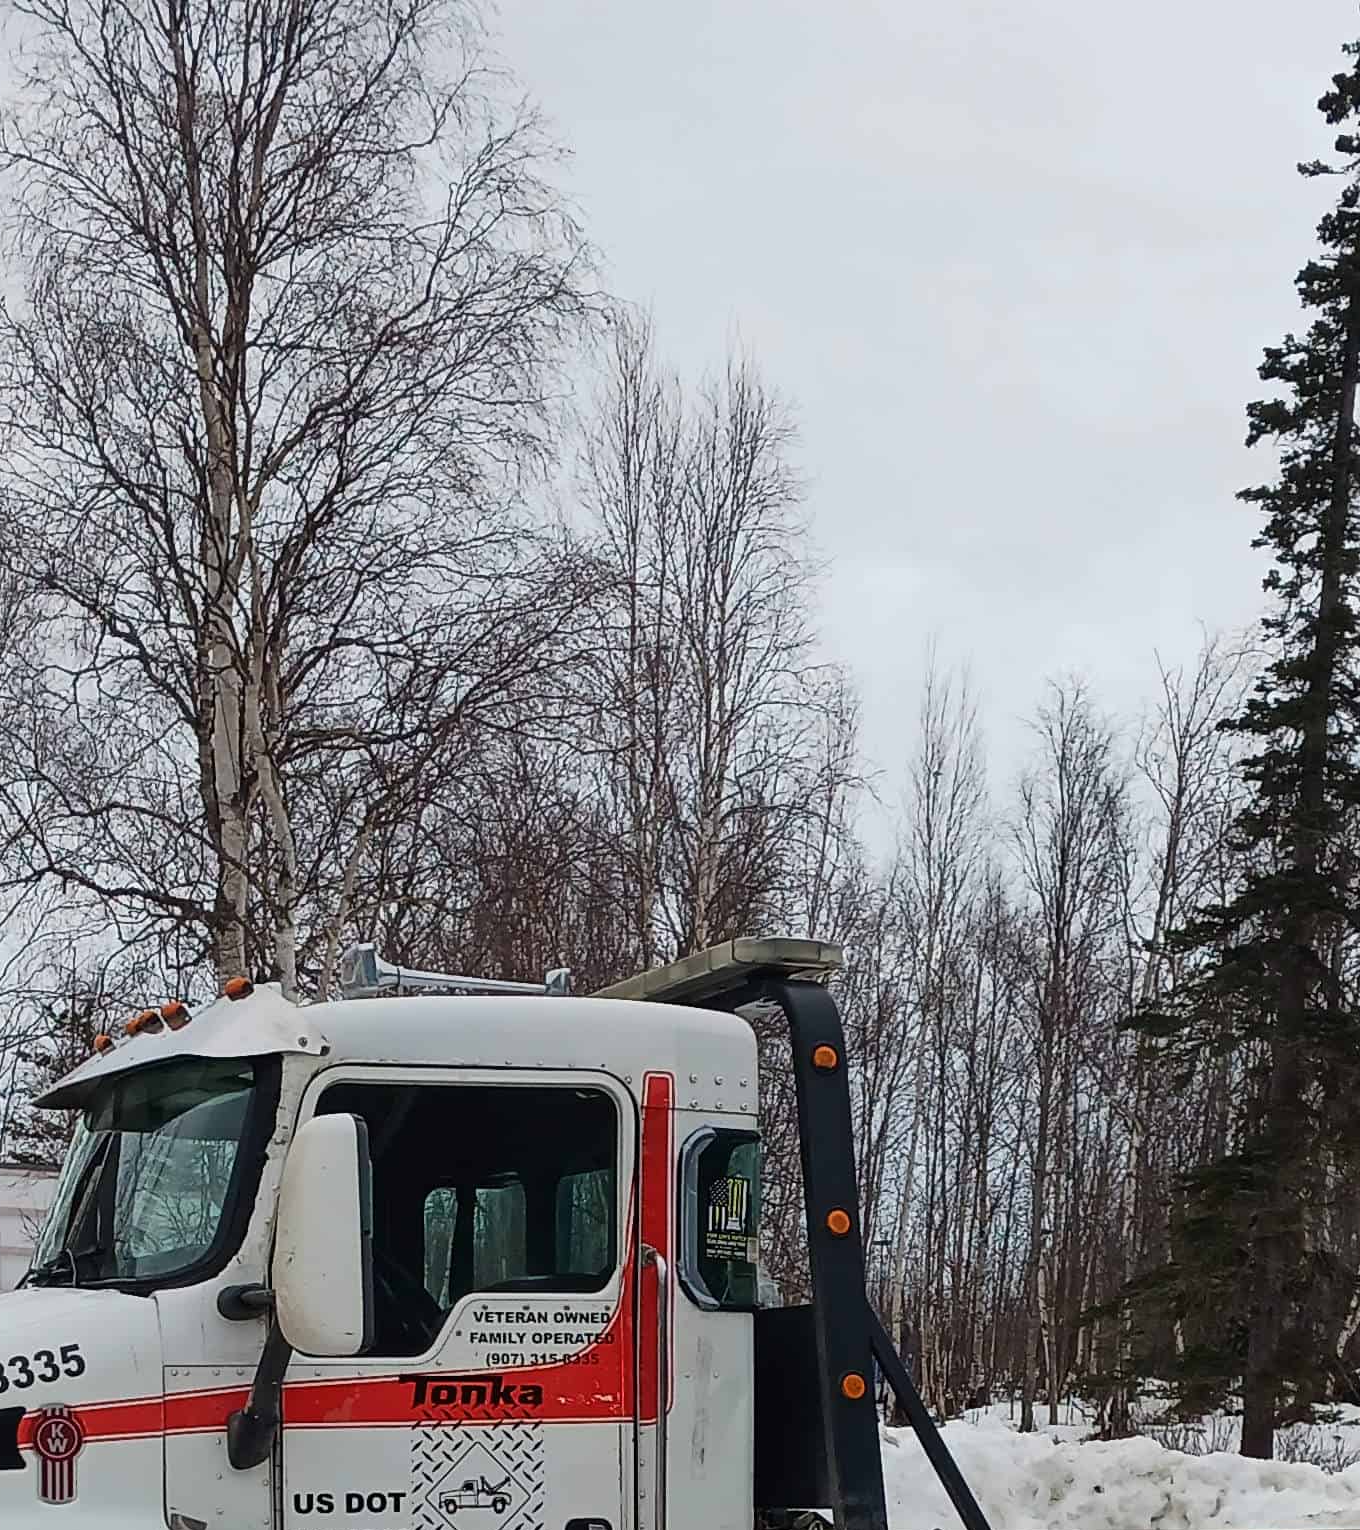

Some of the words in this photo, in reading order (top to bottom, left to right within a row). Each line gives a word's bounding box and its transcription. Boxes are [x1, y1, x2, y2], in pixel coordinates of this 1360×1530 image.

[473, 1311, 548, 1324] VETERAN
[553, 1311, 610, 1324] OWNED
[470, 1332, 525, 1345] FAMILY
[531, 1332, 615, 1345] OPERATED
[486, 1353, 525, 1367] (907)
[399, 1374, 544, 1408] Tonka
[293, 1493, 334, 1514] US
[345, 1492, 406, 1513] DOT
